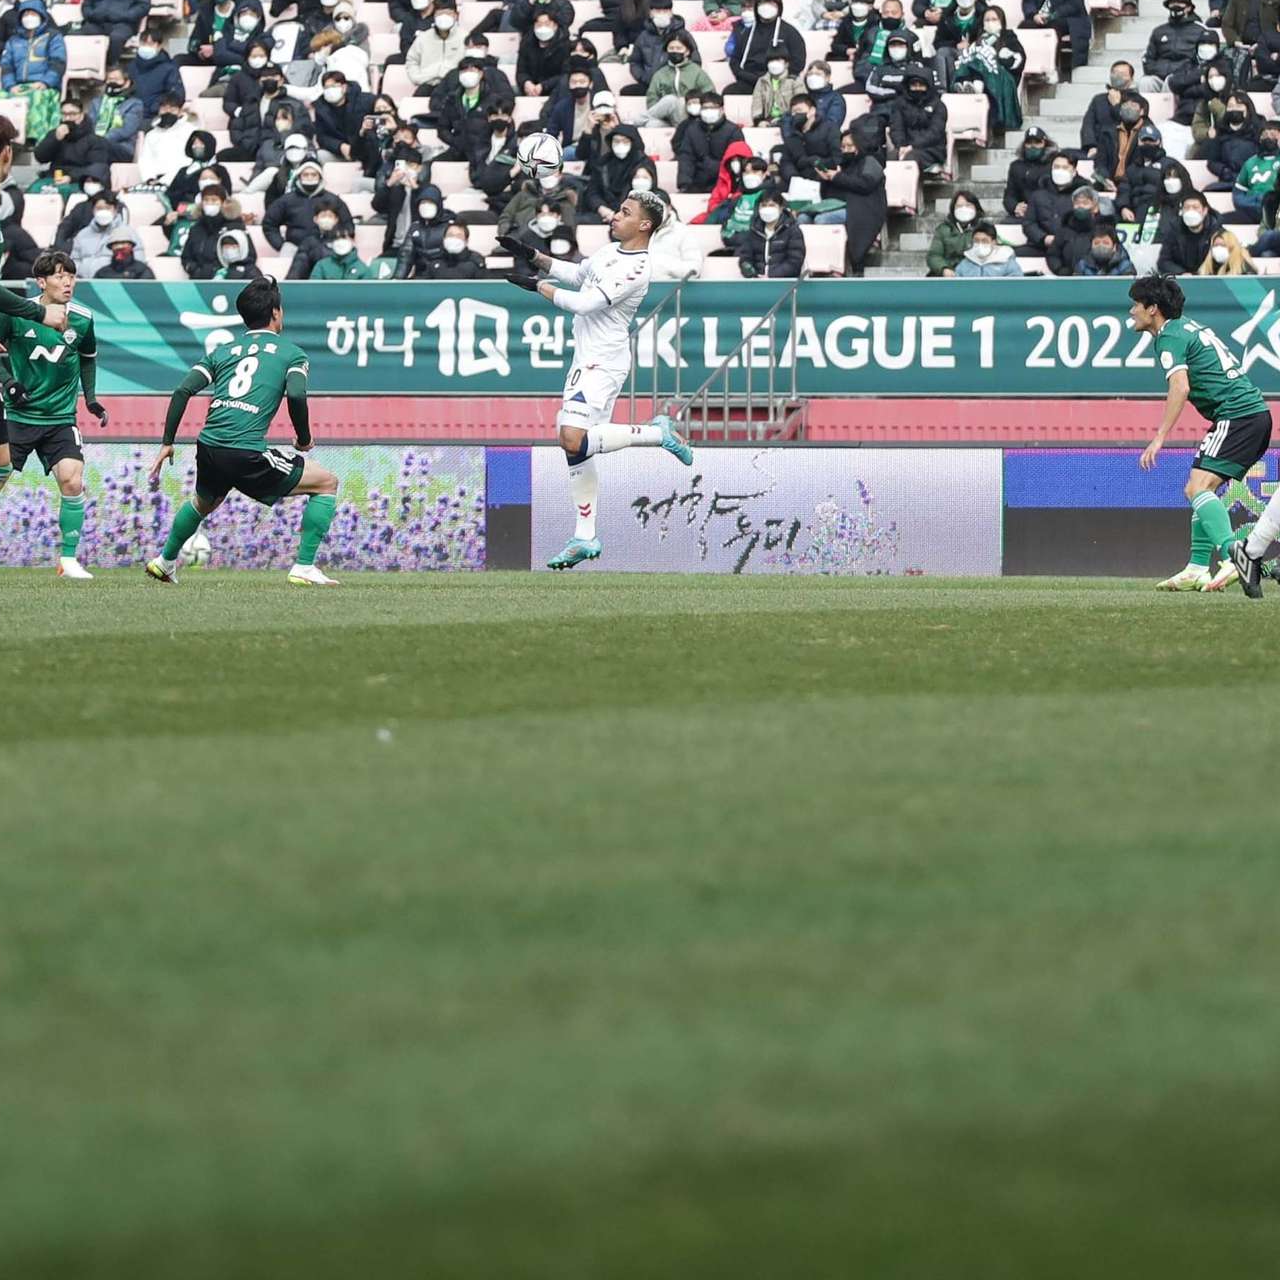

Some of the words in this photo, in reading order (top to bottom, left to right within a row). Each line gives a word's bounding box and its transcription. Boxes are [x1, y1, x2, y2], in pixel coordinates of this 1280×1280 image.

[326, 315, 421, 368] 하나
[522, 314, 576, 368] 원
[636, 317, 689, 368] K
[702, 315, 955, 369] LEAGUE
[972, 316, 995, 368] 1
[1025, 315, 1155, 369] 2022
[228, 356, 260, 399] 8
